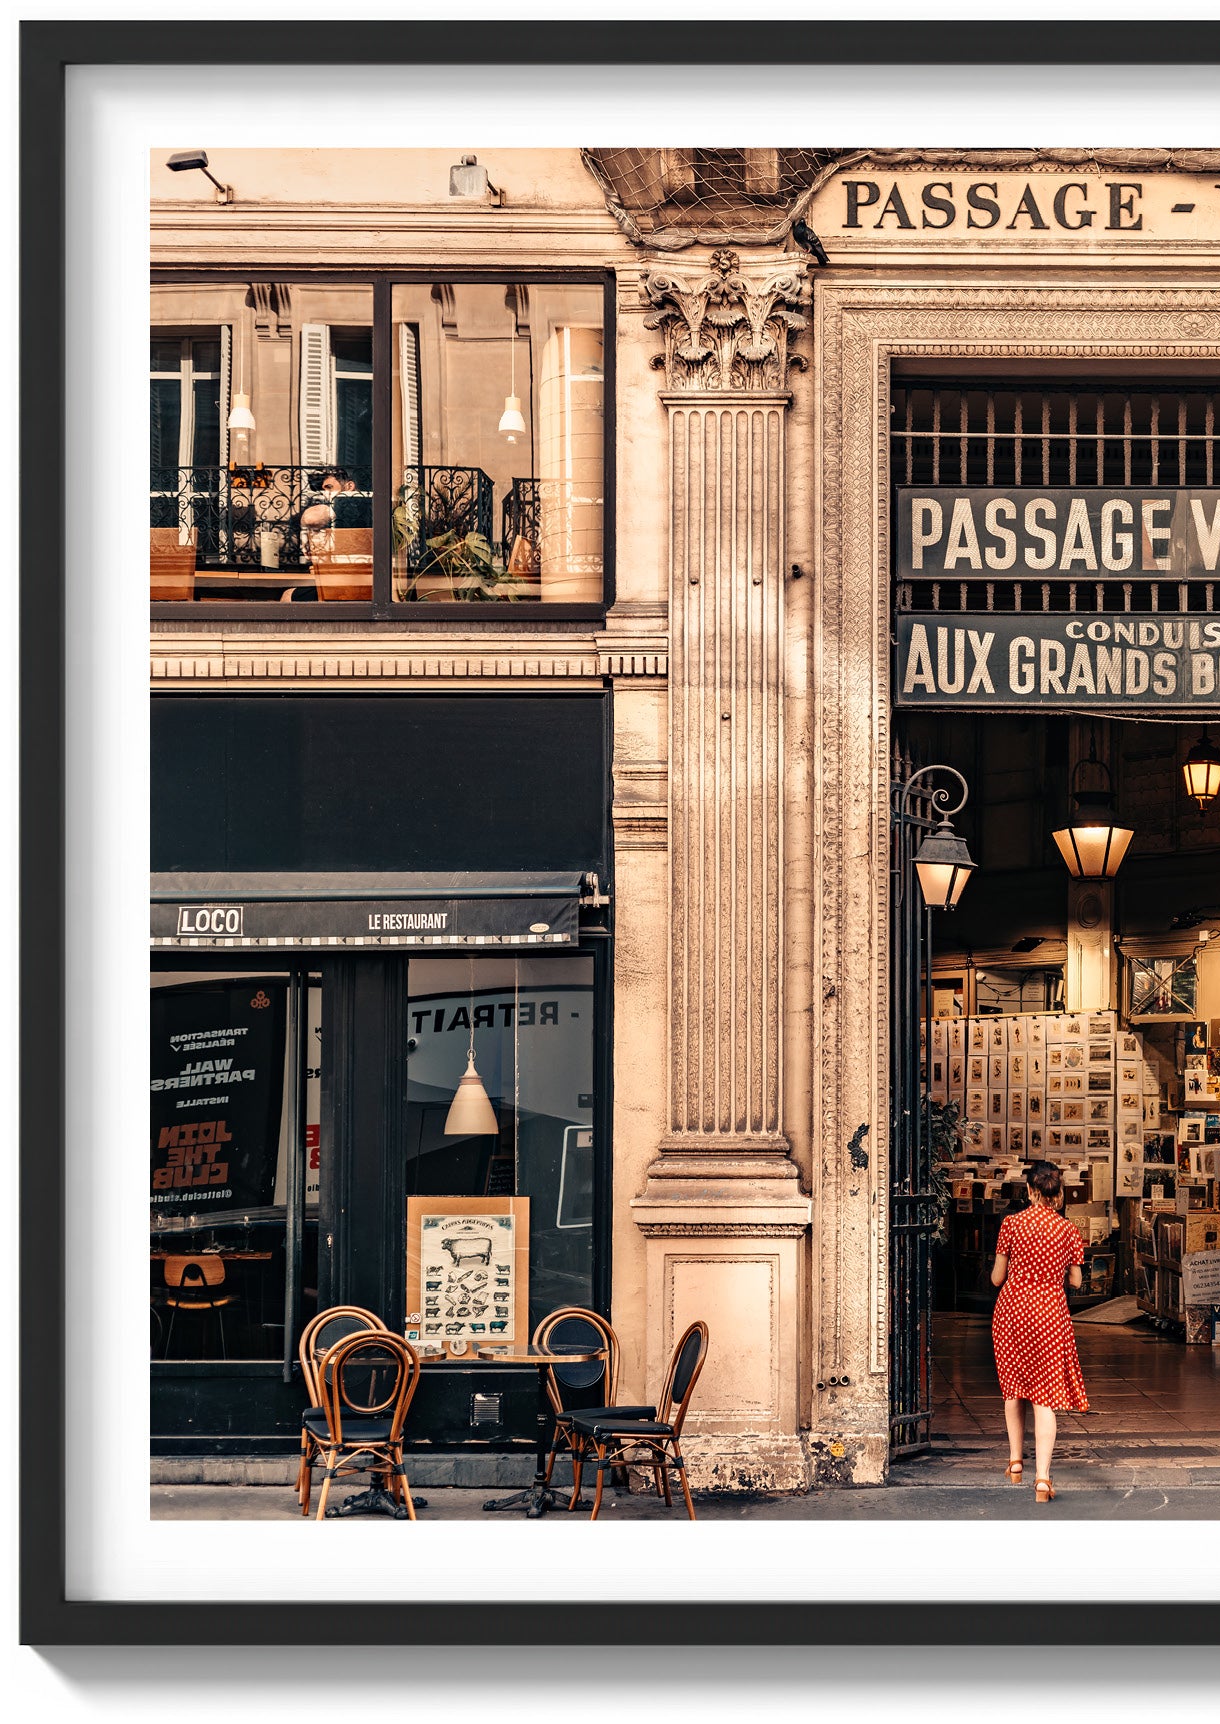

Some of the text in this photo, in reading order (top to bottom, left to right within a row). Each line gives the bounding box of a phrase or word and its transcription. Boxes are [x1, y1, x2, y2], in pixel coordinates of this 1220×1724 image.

[842, 180, 1143, 230] PASSAGE
[911, 497, 1171, 571] PASSAGE
[902, 624, 996, 694] AUX
[1009, 635, 1177, 695] GRANDS
[181, 908, 240, 933] LOCO
[368, 912, 447, 930] LE RESTAURANT
